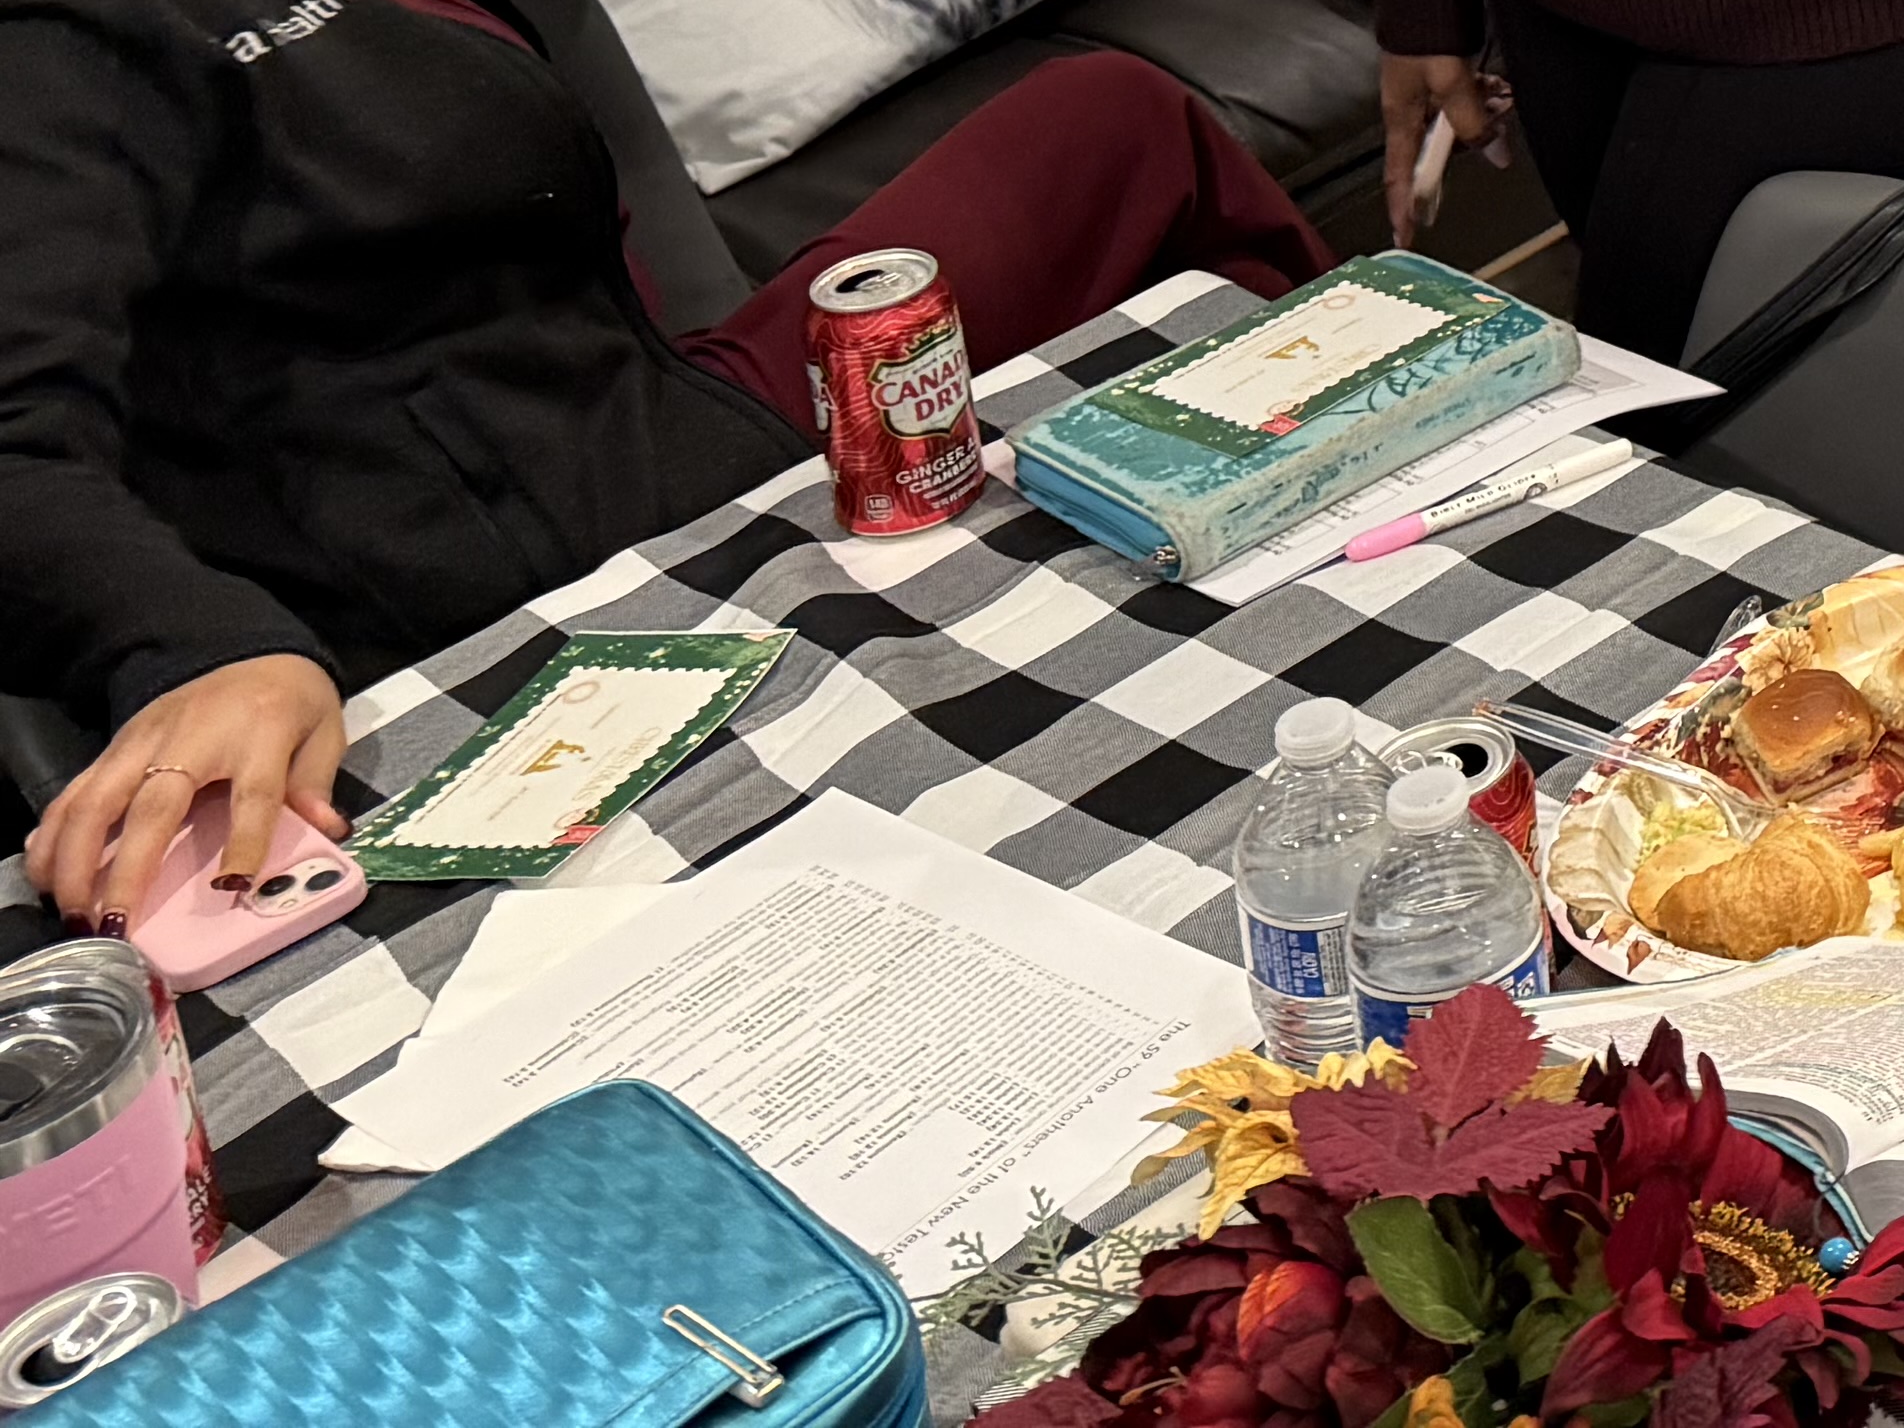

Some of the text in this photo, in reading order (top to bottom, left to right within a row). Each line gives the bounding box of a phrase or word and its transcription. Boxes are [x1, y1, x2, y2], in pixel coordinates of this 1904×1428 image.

[873, 349, 969, 407] CANAD
[915, 376, 966, 423] DRY
[896, 446, 965, 486] GINGER
[1158, 1021, 1192, 1042] The
[1140, 1043, 1161, 1060] 59
[1094, 1062, 1141, 1094] "One
[997, 1157, 1017, 1174] of
[967, 1172, 999, 1195] the
[927, 1195, 970, 1228] New
